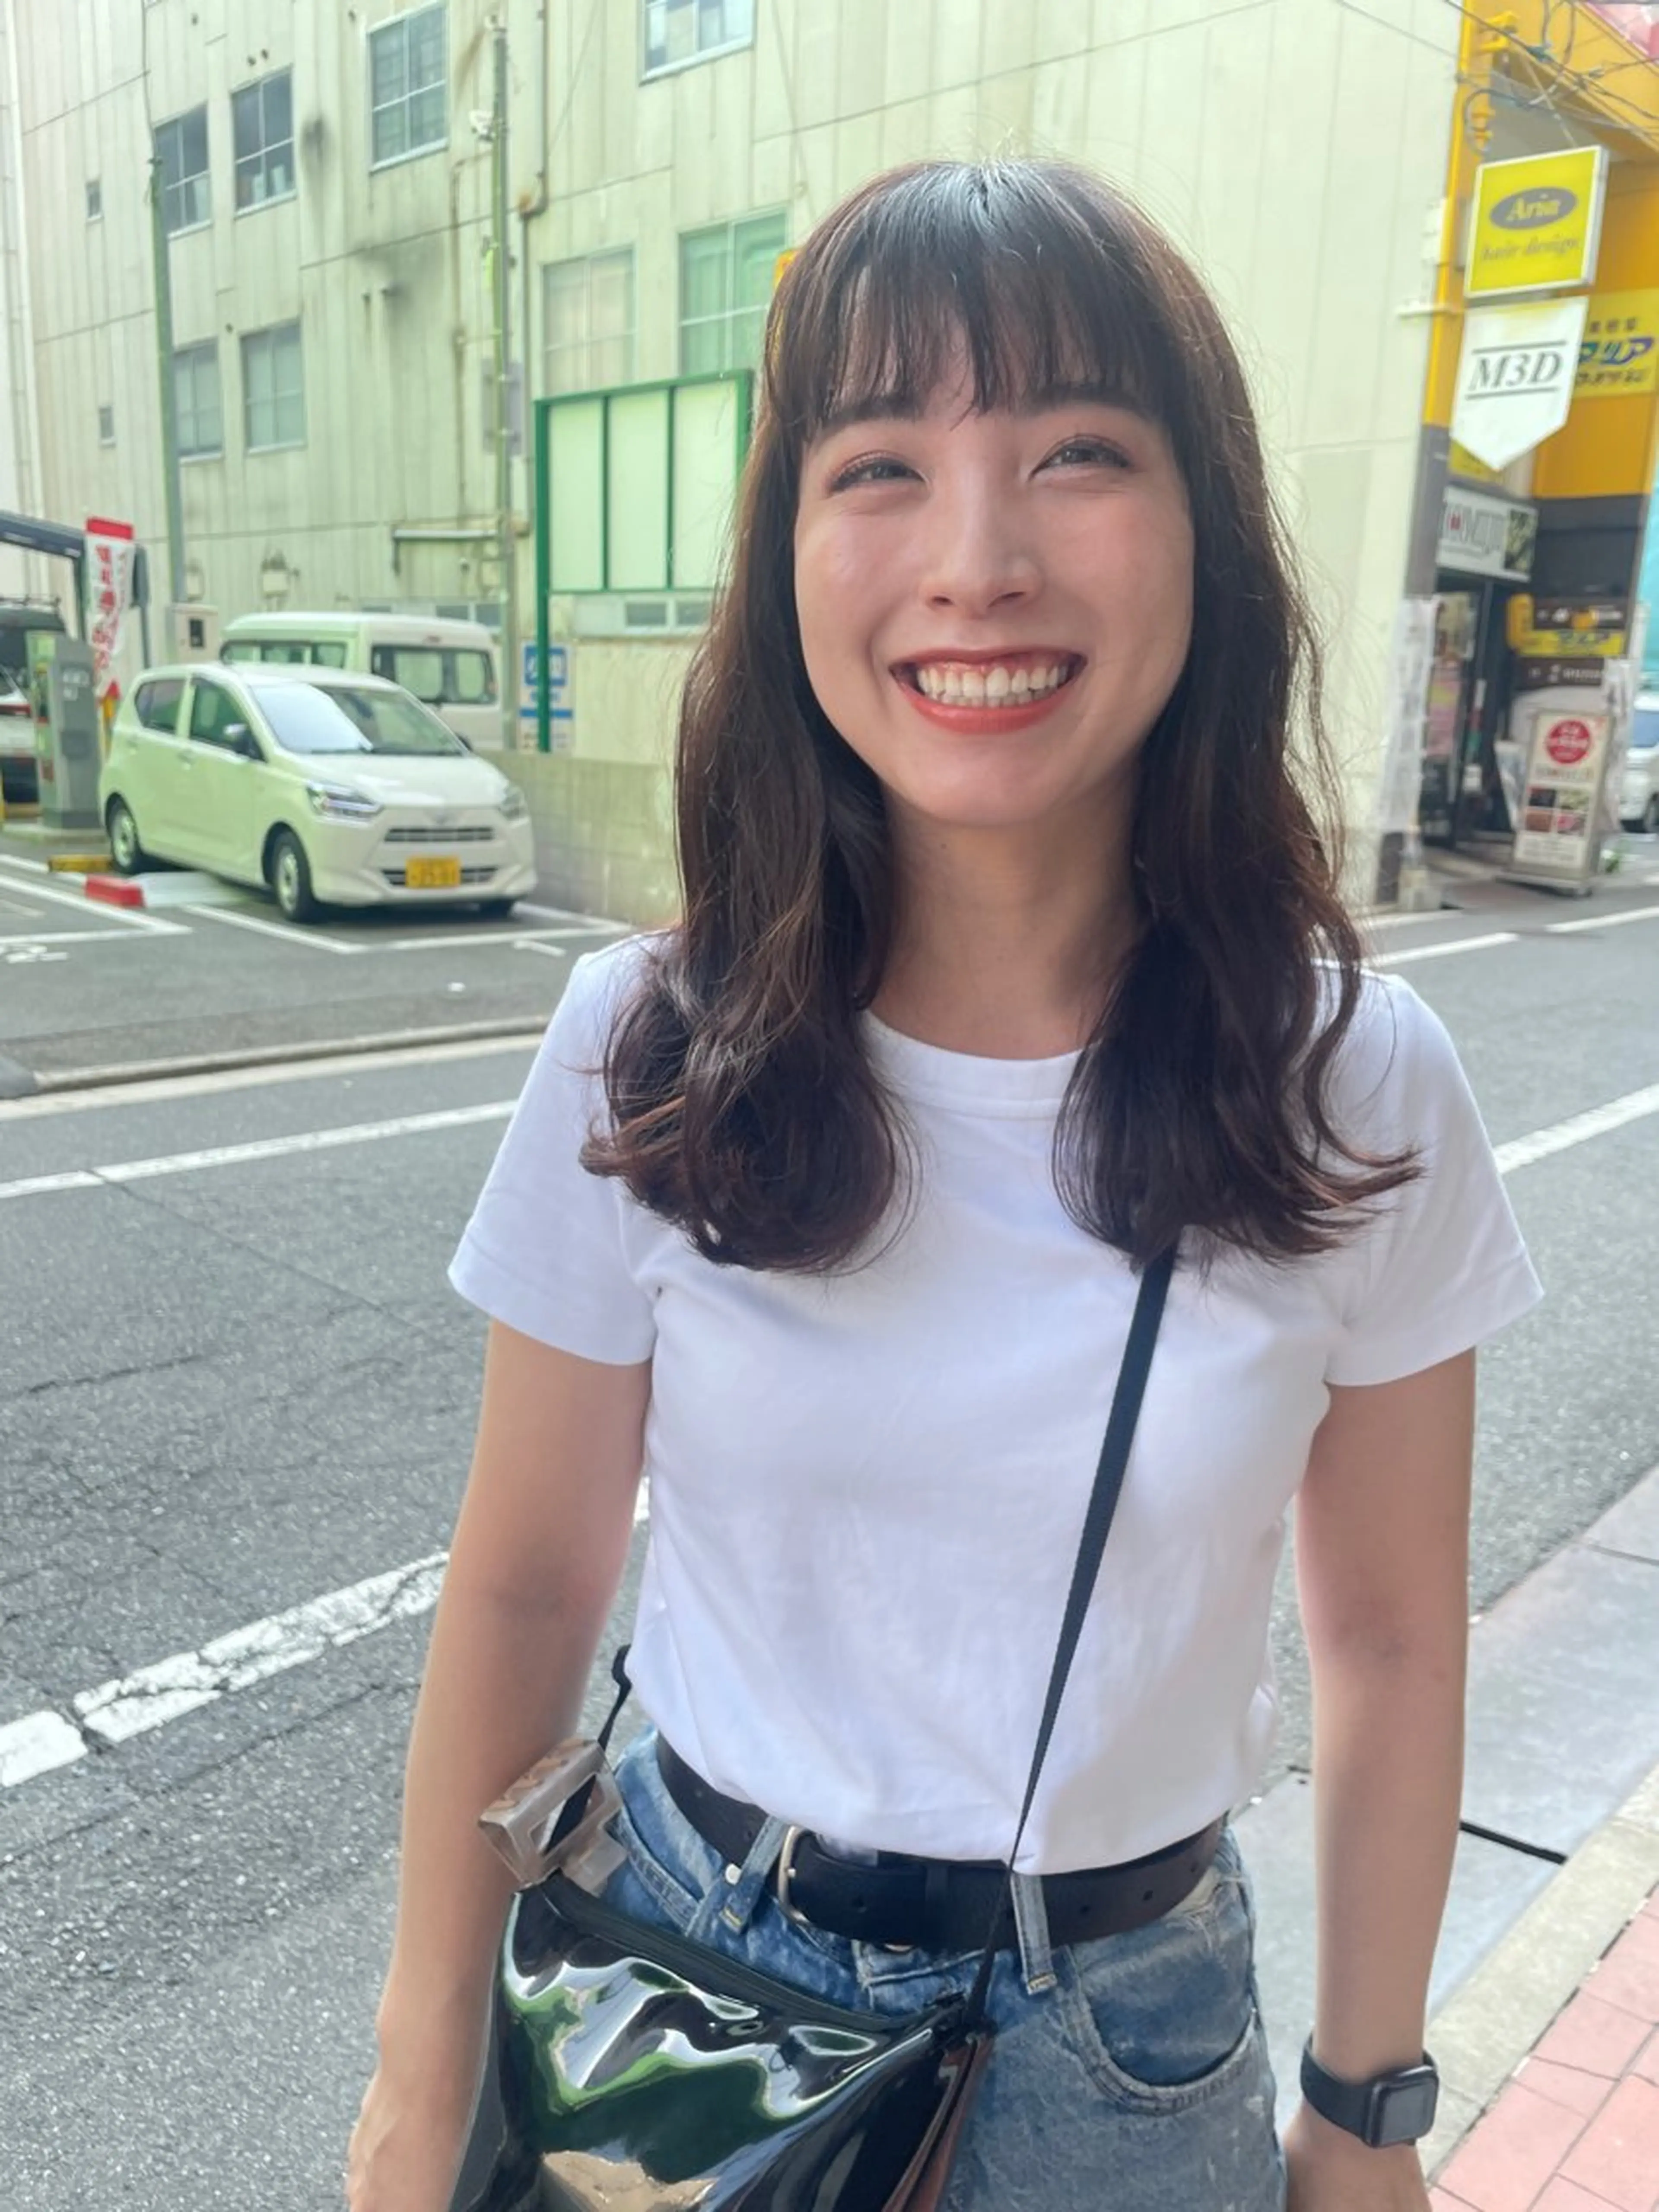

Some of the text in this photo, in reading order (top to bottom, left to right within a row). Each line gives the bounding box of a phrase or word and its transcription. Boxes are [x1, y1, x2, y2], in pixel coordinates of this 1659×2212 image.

[1506, 193, 1562, 222] Aria
[1482, 240, 1519, 261] hair
[1468, 350, 1564, 391] M3D
